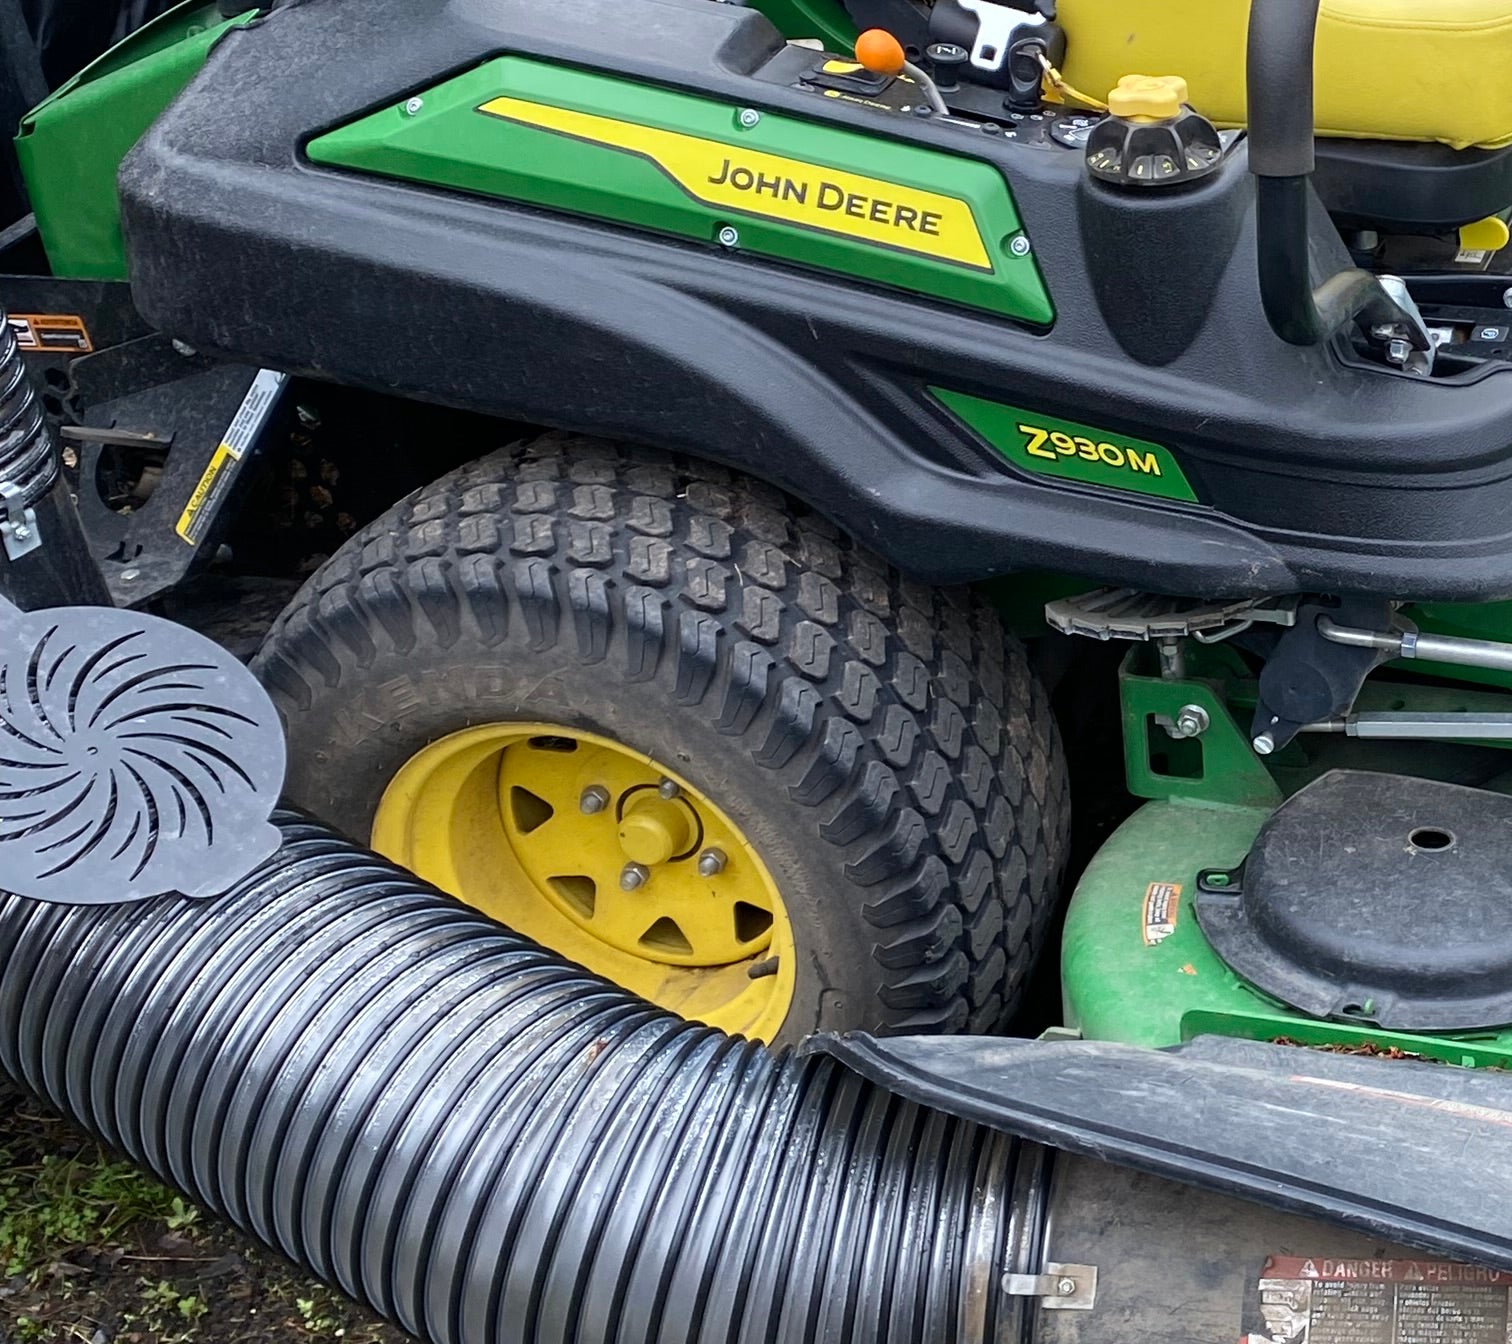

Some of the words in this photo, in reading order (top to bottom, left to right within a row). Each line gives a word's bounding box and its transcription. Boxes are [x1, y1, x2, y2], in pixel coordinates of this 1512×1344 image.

[708, 159, 808, 205] JOHN
[816, 182, 943, 236] DEERE
[1018, 424, 1162, 476] Z930M
[190, 464, 217, 508] CAUTION
[1322, 1259, 1393, 1278] DANGER
